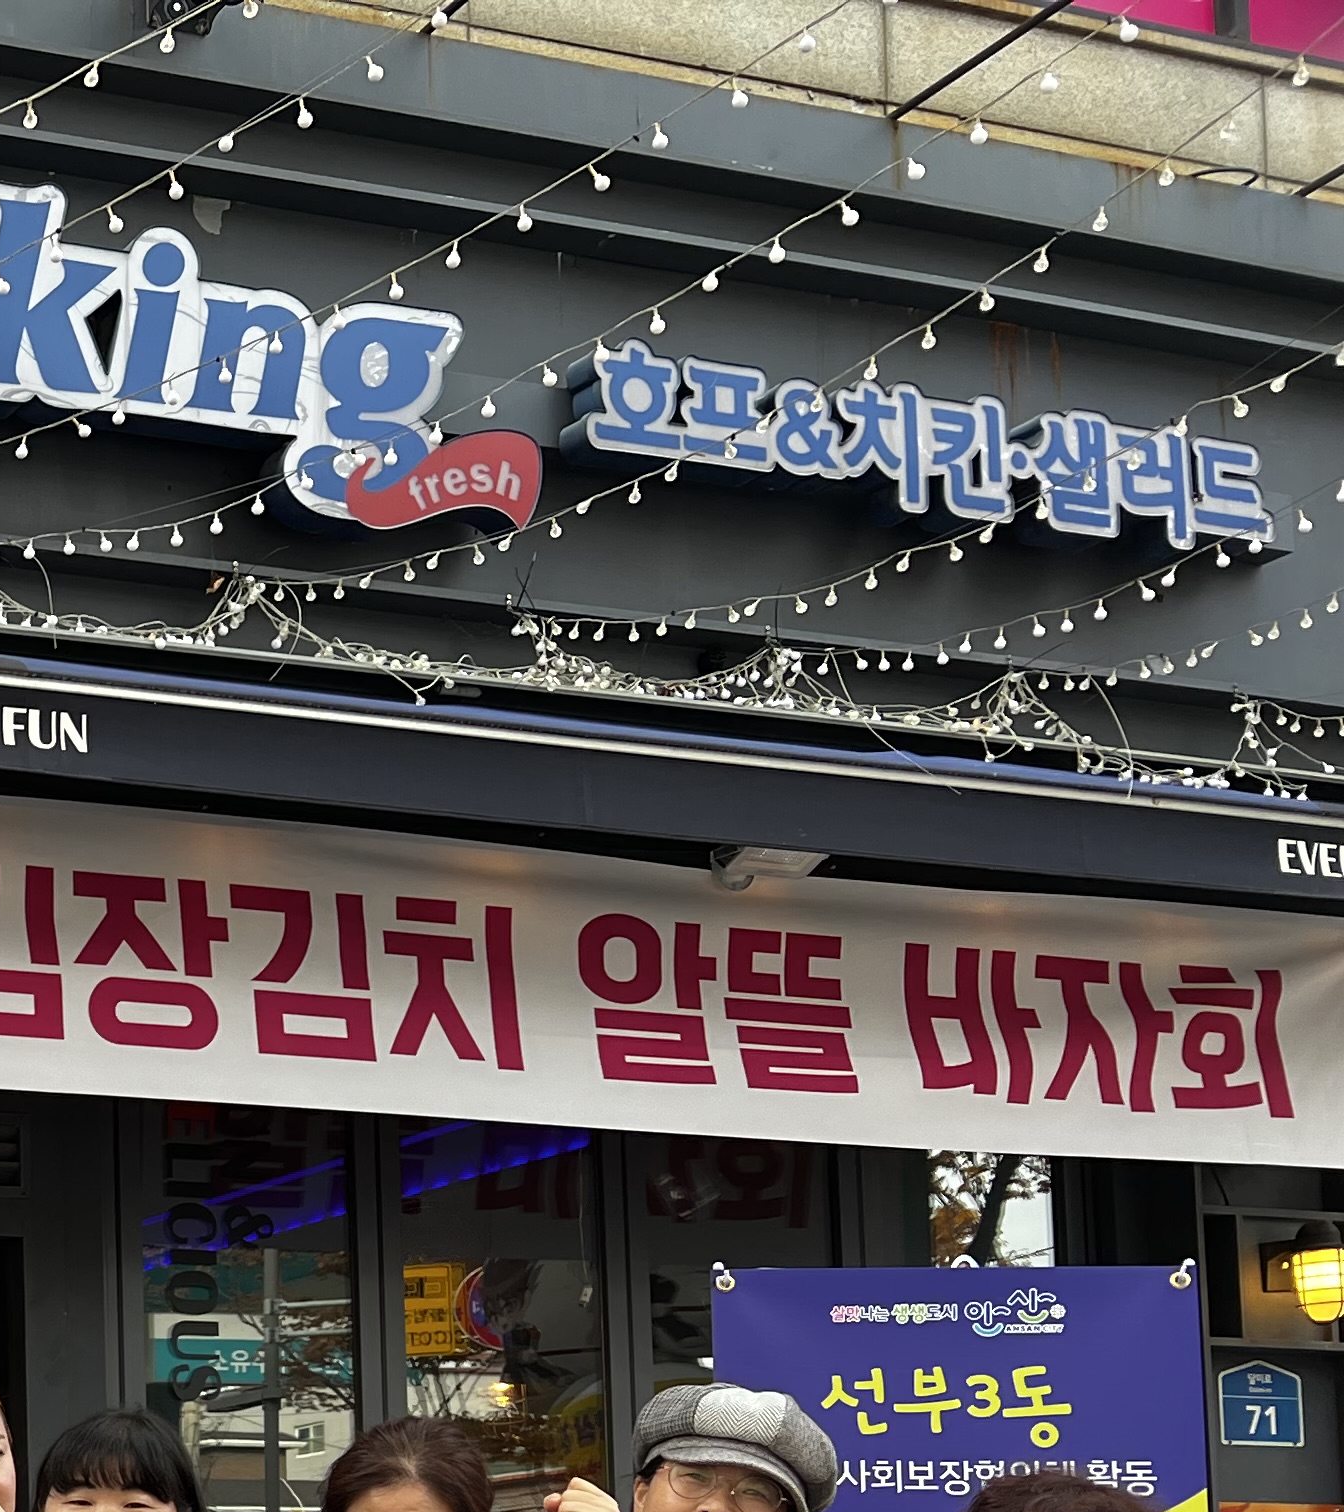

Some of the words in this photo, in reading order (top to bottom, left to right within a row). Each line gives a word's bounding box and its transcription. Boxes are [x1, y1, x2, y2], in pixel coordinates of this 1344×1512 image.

[406, 457, 523, 509] fresh
[1, 706, 89, 750] FUN
[1278, 838, 1344, 878] EVE
[576, 910, 859, 1097] 알뜰
[904, 941, 1296, 1120] 바자회
[830, 1304, 890, 1323] 살맛나는
[891, 1303, 959, 1324] 생생도시
[1004, 1323, 1041, 1334] ANSAN
[821, 1365, 1072, 1448] 선부3동
[1245, 1404, 1278, 1436] 71
